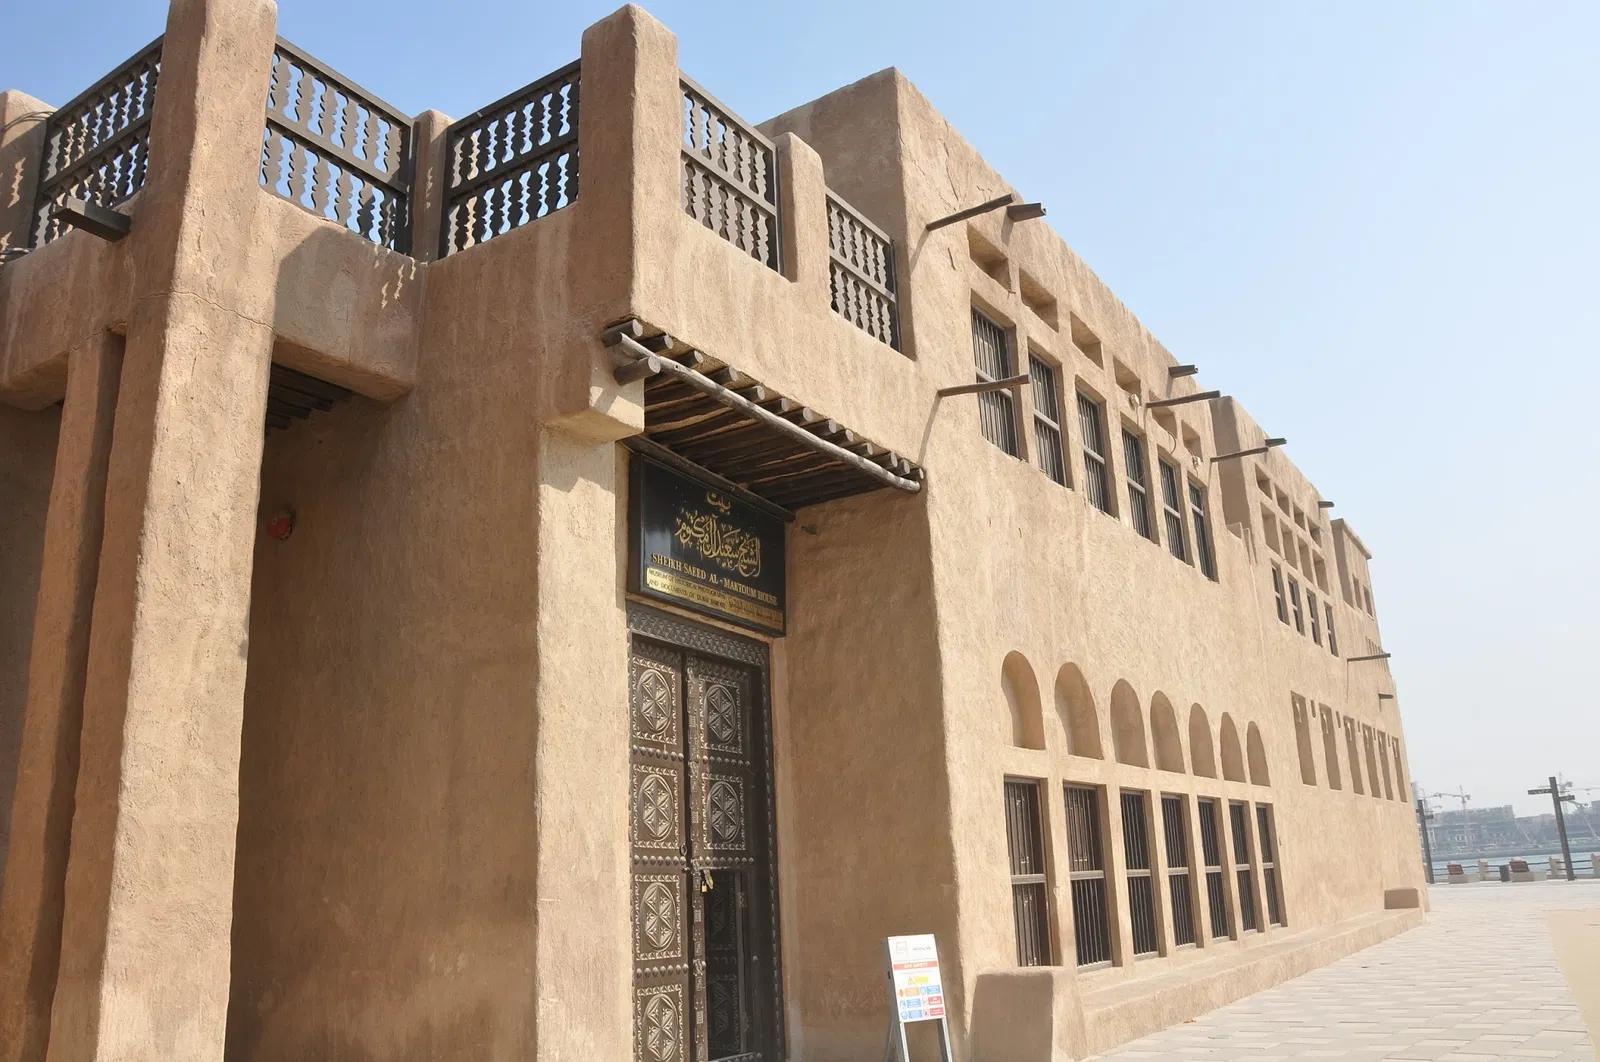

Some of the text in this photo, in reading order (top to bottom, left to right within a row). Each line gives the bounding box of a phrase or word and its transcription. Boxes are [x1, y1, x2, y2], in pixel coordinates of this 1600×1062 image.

[706, 491, 731, 515] بيت
[738, 533, 761, 578] الشيخ
[648, 569, 668, 581] MUSEUM
[668, 575, 675, 583] OF
[649, 579, 659, 587] AND
[660, 582, 688, 596] DOCUMENTS
[652, 552, 682, 571] SHEIKH
[683, 563, 706, 580] SAEED
[757, 590, 778, 606] HOUSE
